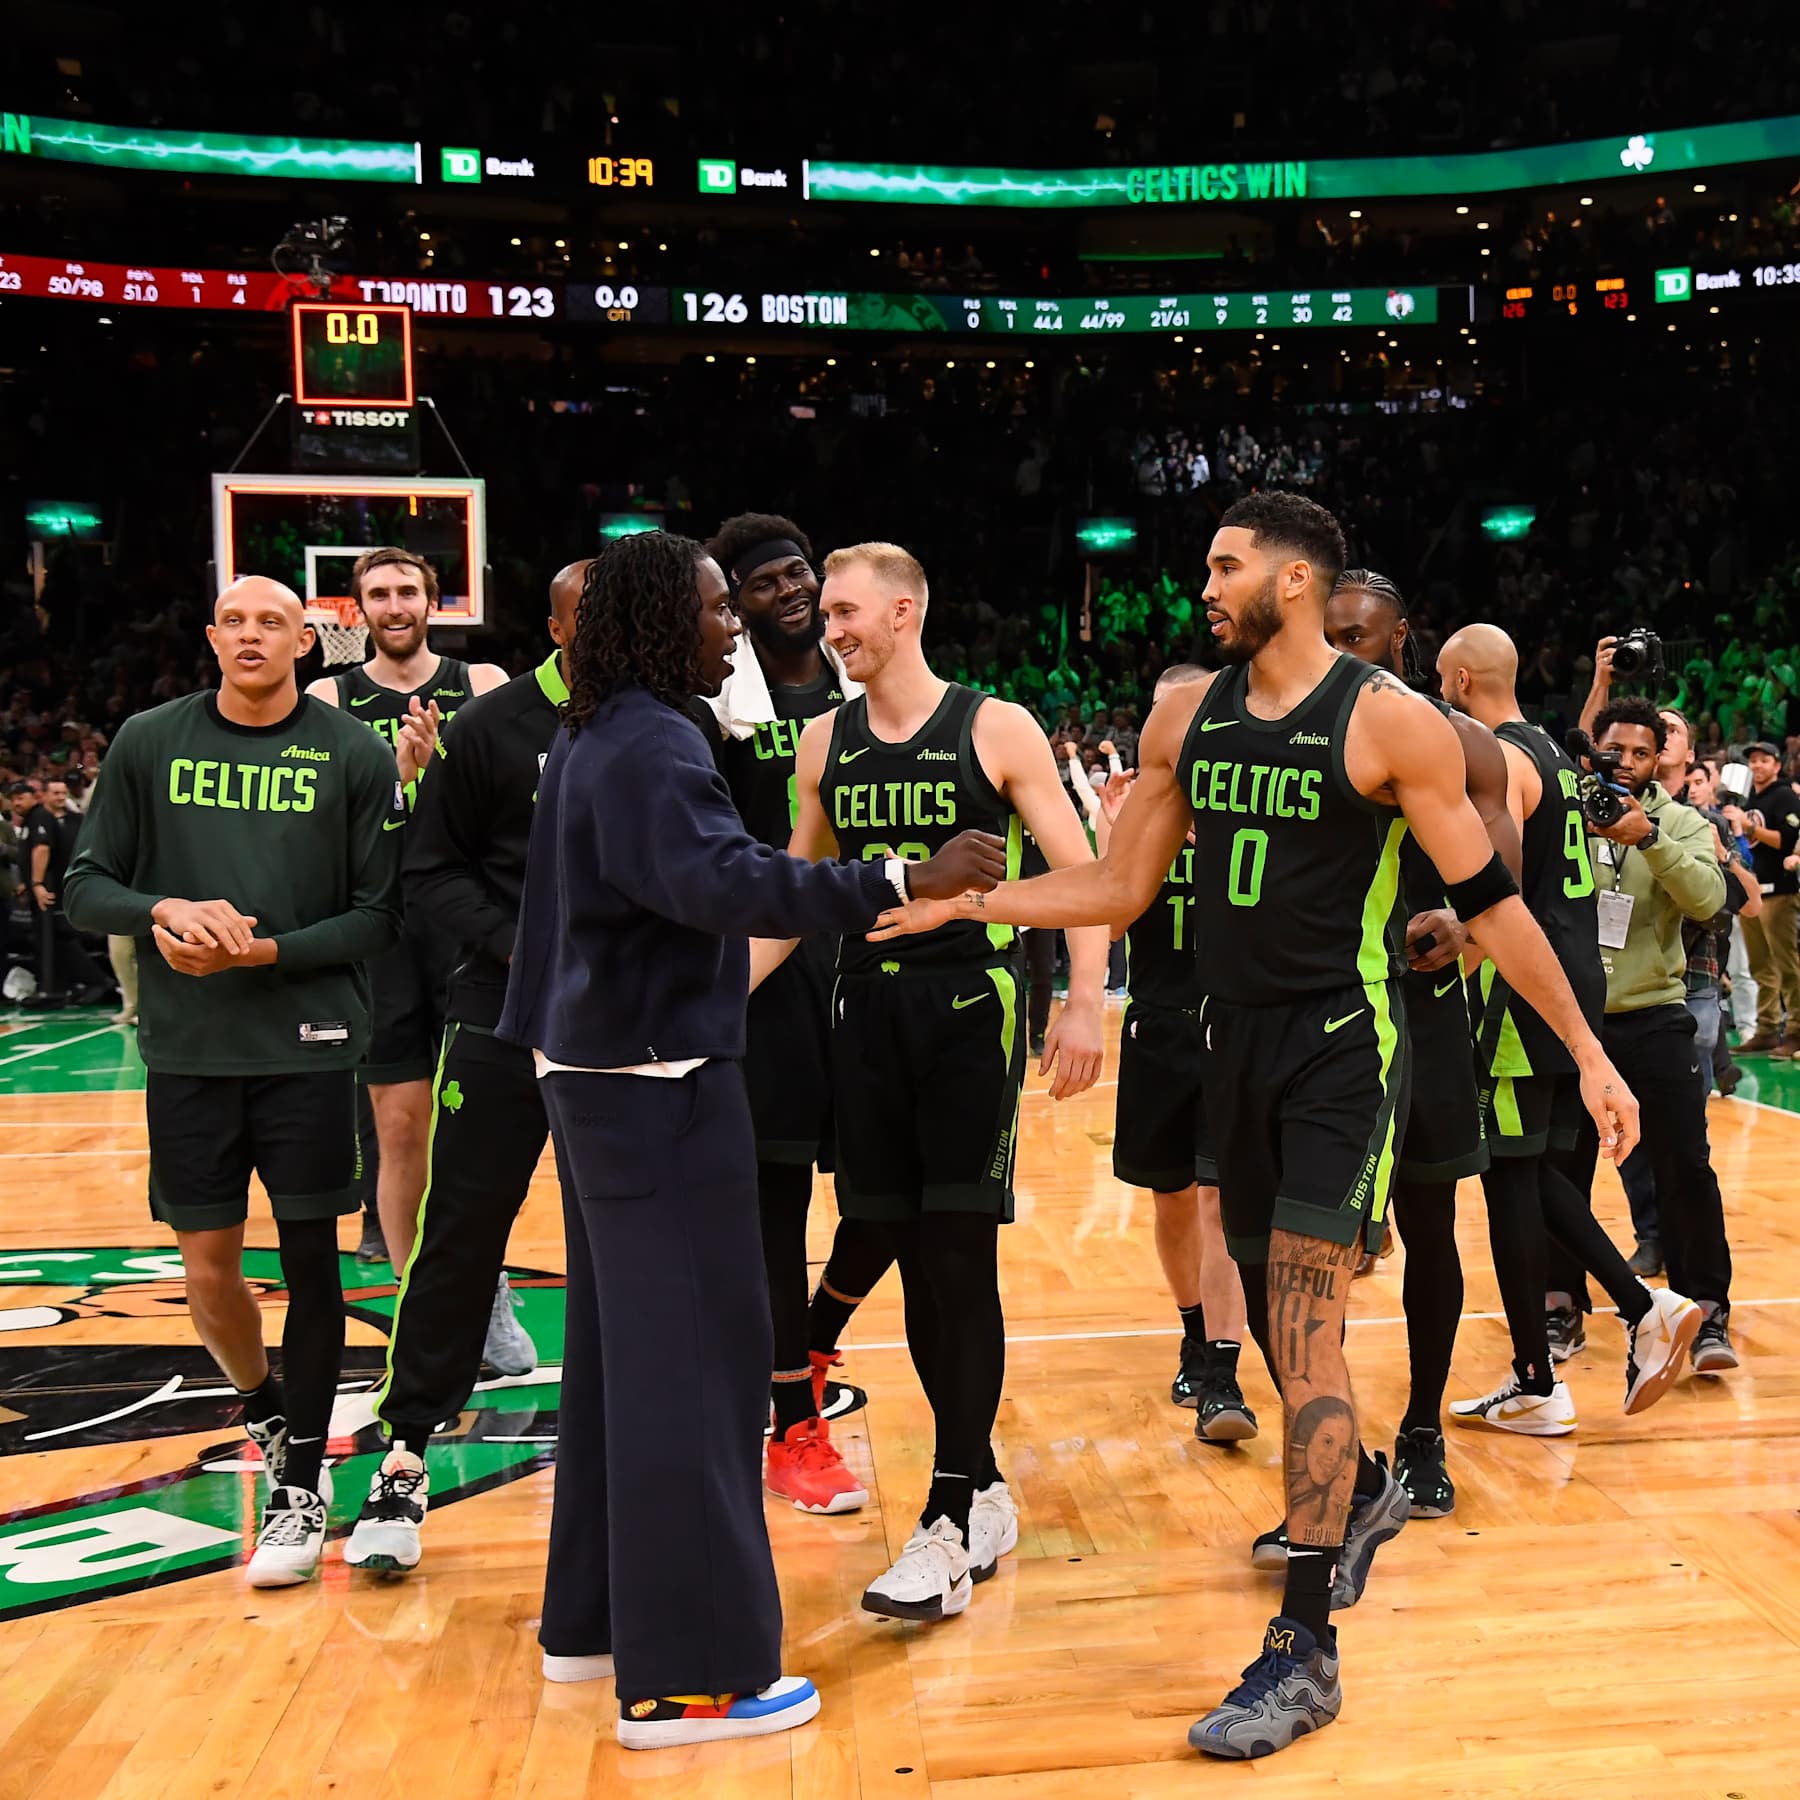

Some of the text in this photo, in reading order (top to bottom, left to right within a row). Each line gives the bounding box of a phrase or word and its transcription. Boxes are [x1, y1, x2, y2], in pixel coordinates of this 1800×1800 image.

[443, 152, 535, 177] TD Bank
[588, 156, 654, 186] 10:39
[701, 164, 788, 187] TD Bank
[1126, 162, 1307, 203] CELTICS WIN
[122, 283, 158, 302] 51.0
[1658, 269, 1741, 296] TD Bank
[192, 286, 201, 303] 1
[232, 287, 246, 304] 4
[488, 286, 555, 317] 123
[595, 285, 639, 309] 0.0
[683, 292, 748, 323] 126
[761, 294, 848, 324] BOSTON
[1150, 310, 1190, 328] 21/61
[1215, 309, 1228, 325] 9
[1256, 308, 1268, 324] 2
[1292, 306, 1313, 323] 30
[1332, 305, 1353, 322] 42
[326, 313, 379, 345] 0.0
[966, 311, 980, 329] 0
[1006, 312, 1014, 329] 1
[1079, 312, 1126, 329] 44/99
[331, 410, 410, 427] TISSOT
[1288, 731, 1330, 746] Amica
[280, 745, 331, 762] Amica
[916, 748, 957, 761] Amica
[169, 758, 318, 813] CELTICS
[1191, 760, 1323, 821] CELTICS
[834, 781, 957, 829] CELTICS
[1563, 810, 1595, 899] 9
[1228, 828, 1269, 907] 0
[990, 1129, 1009, 1179] BOSTON
[1350, 1153, 1377, 1210] BOSTON
